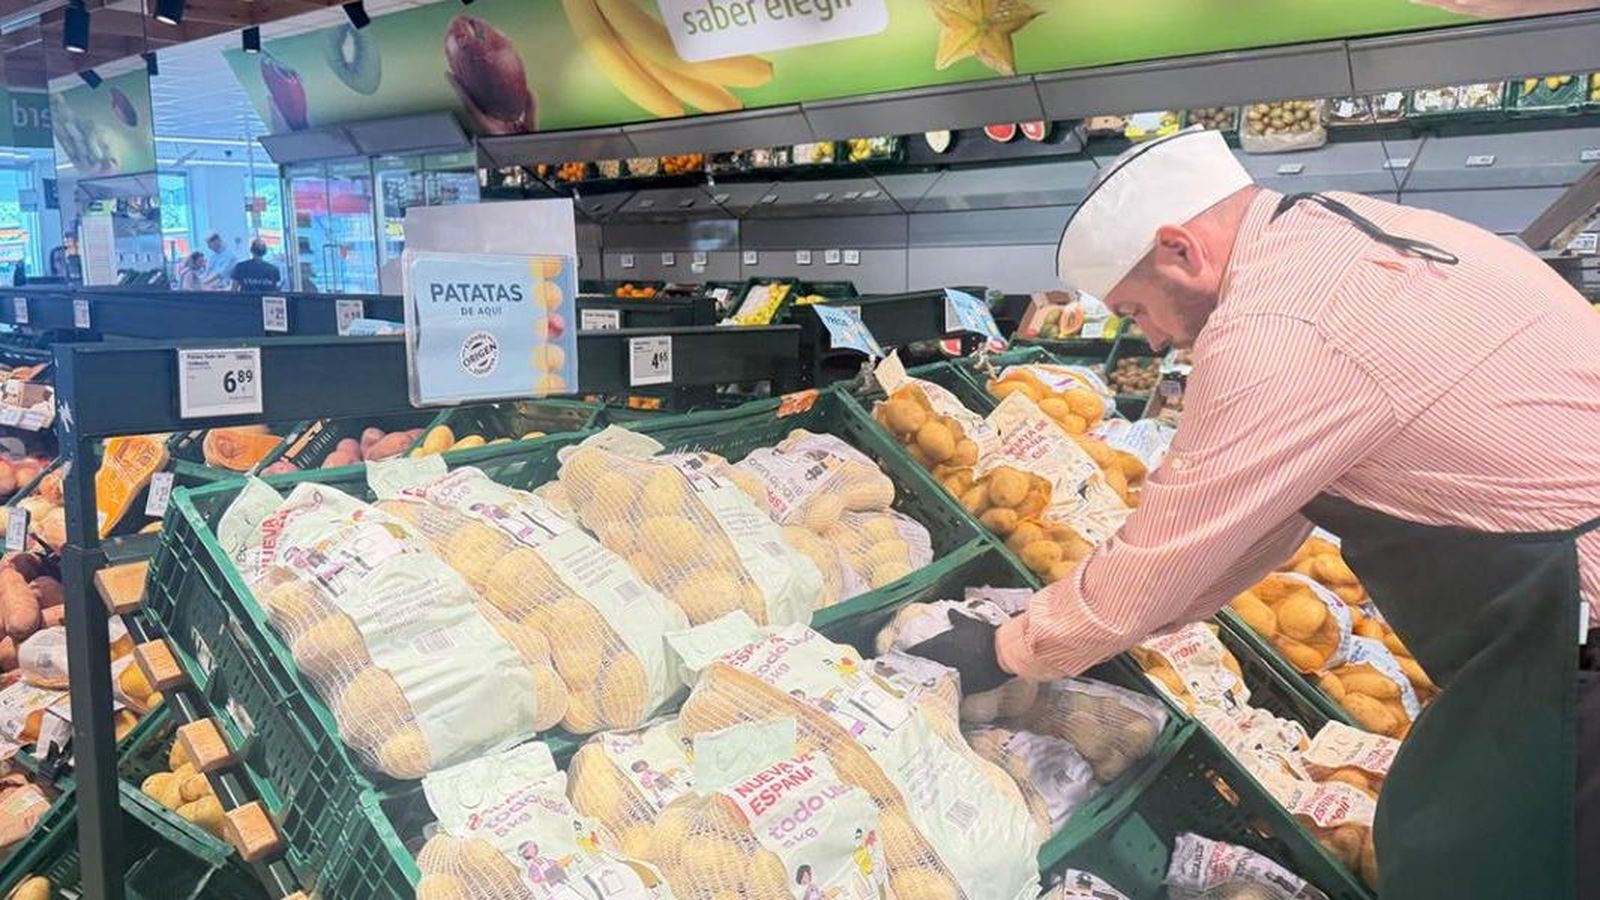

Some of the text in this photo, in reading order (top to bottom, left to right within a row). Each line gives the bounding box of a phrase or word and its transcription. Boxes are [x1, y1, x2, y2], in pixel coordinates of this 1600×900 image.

[682, 0, 759, 35] saber
[430, 283, 523, 302] PATATAS
[461, 306, 473, 316] DE
[462, 342, 497, 368] ORIGEN
[734, 760, 795, 798] NUEVA
[769, 795, 824, 840] todo
